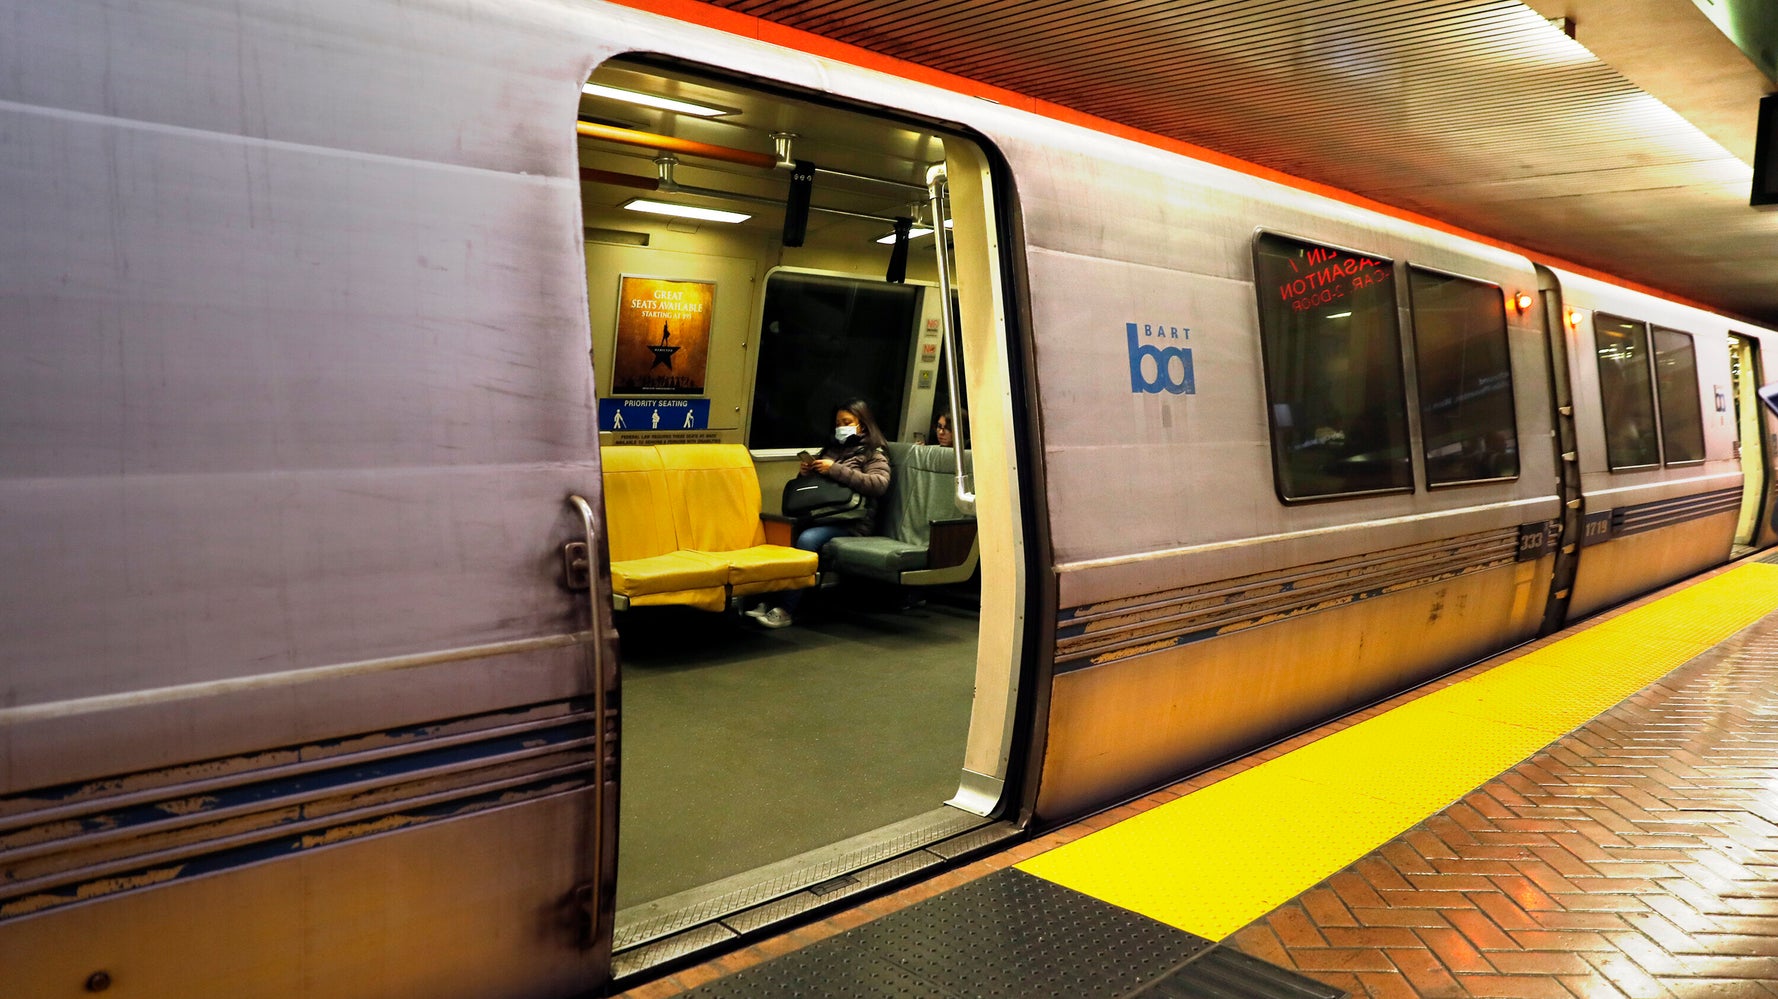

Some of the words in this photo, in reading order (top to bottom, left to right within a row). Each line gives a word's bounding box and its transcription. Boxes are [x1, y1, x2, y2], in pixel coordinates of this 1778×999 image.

[653, 289, 684, 300] GREAT
[631, 299, 657, 309] SEATS
[658, 301, 703, 312] AVAILABLE
[641, 311, 672, 319] STARTING
[1144, 324, 1191, 340] BART
[1585, 520, 1608, 537] 1719
[1520, 532, 1543, 551] 333
